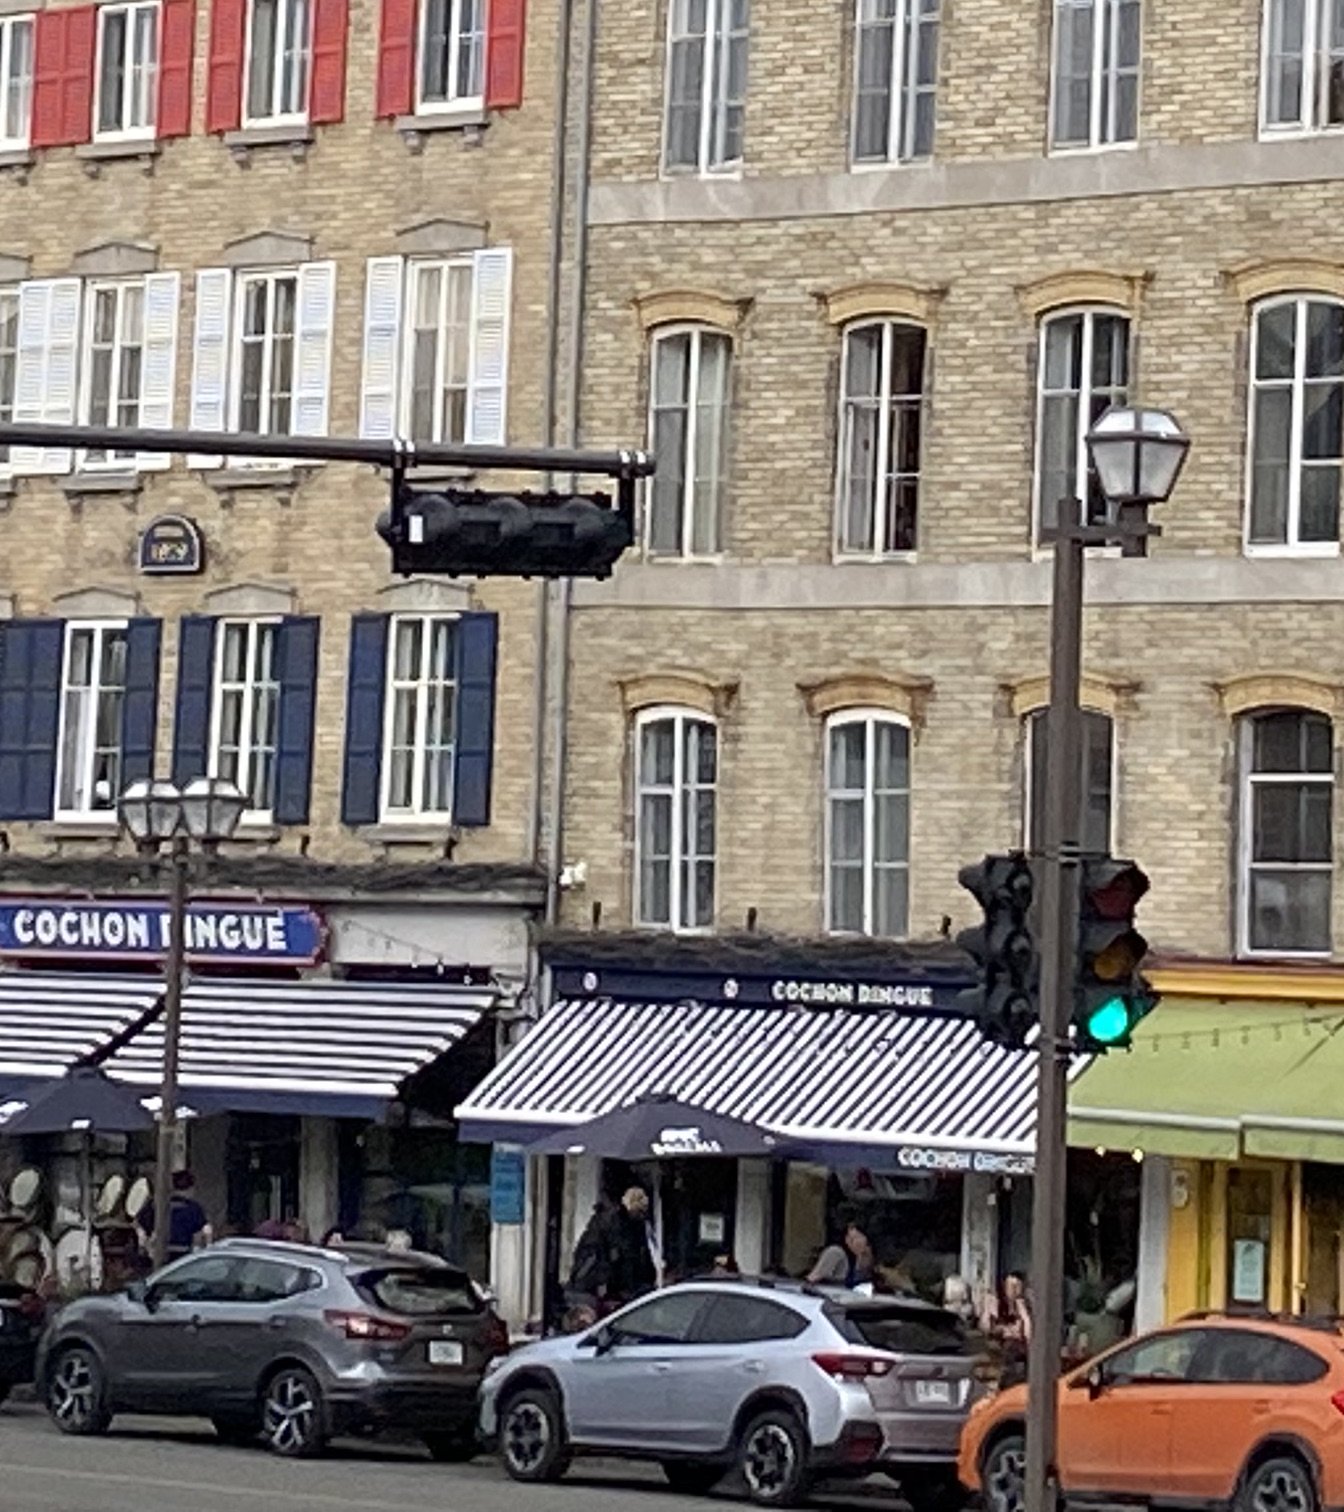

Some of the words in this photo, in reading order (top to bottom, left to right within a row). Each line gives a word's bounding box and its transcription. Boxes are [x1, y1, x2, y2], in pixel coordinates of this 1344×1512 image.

[14, 909, 150, 948] COCHON
[771, 980, 854, 1004] COCHON
[857, 984, 934, 1007] DINGUE
[897, 1146, 971, 1170] COCHON
